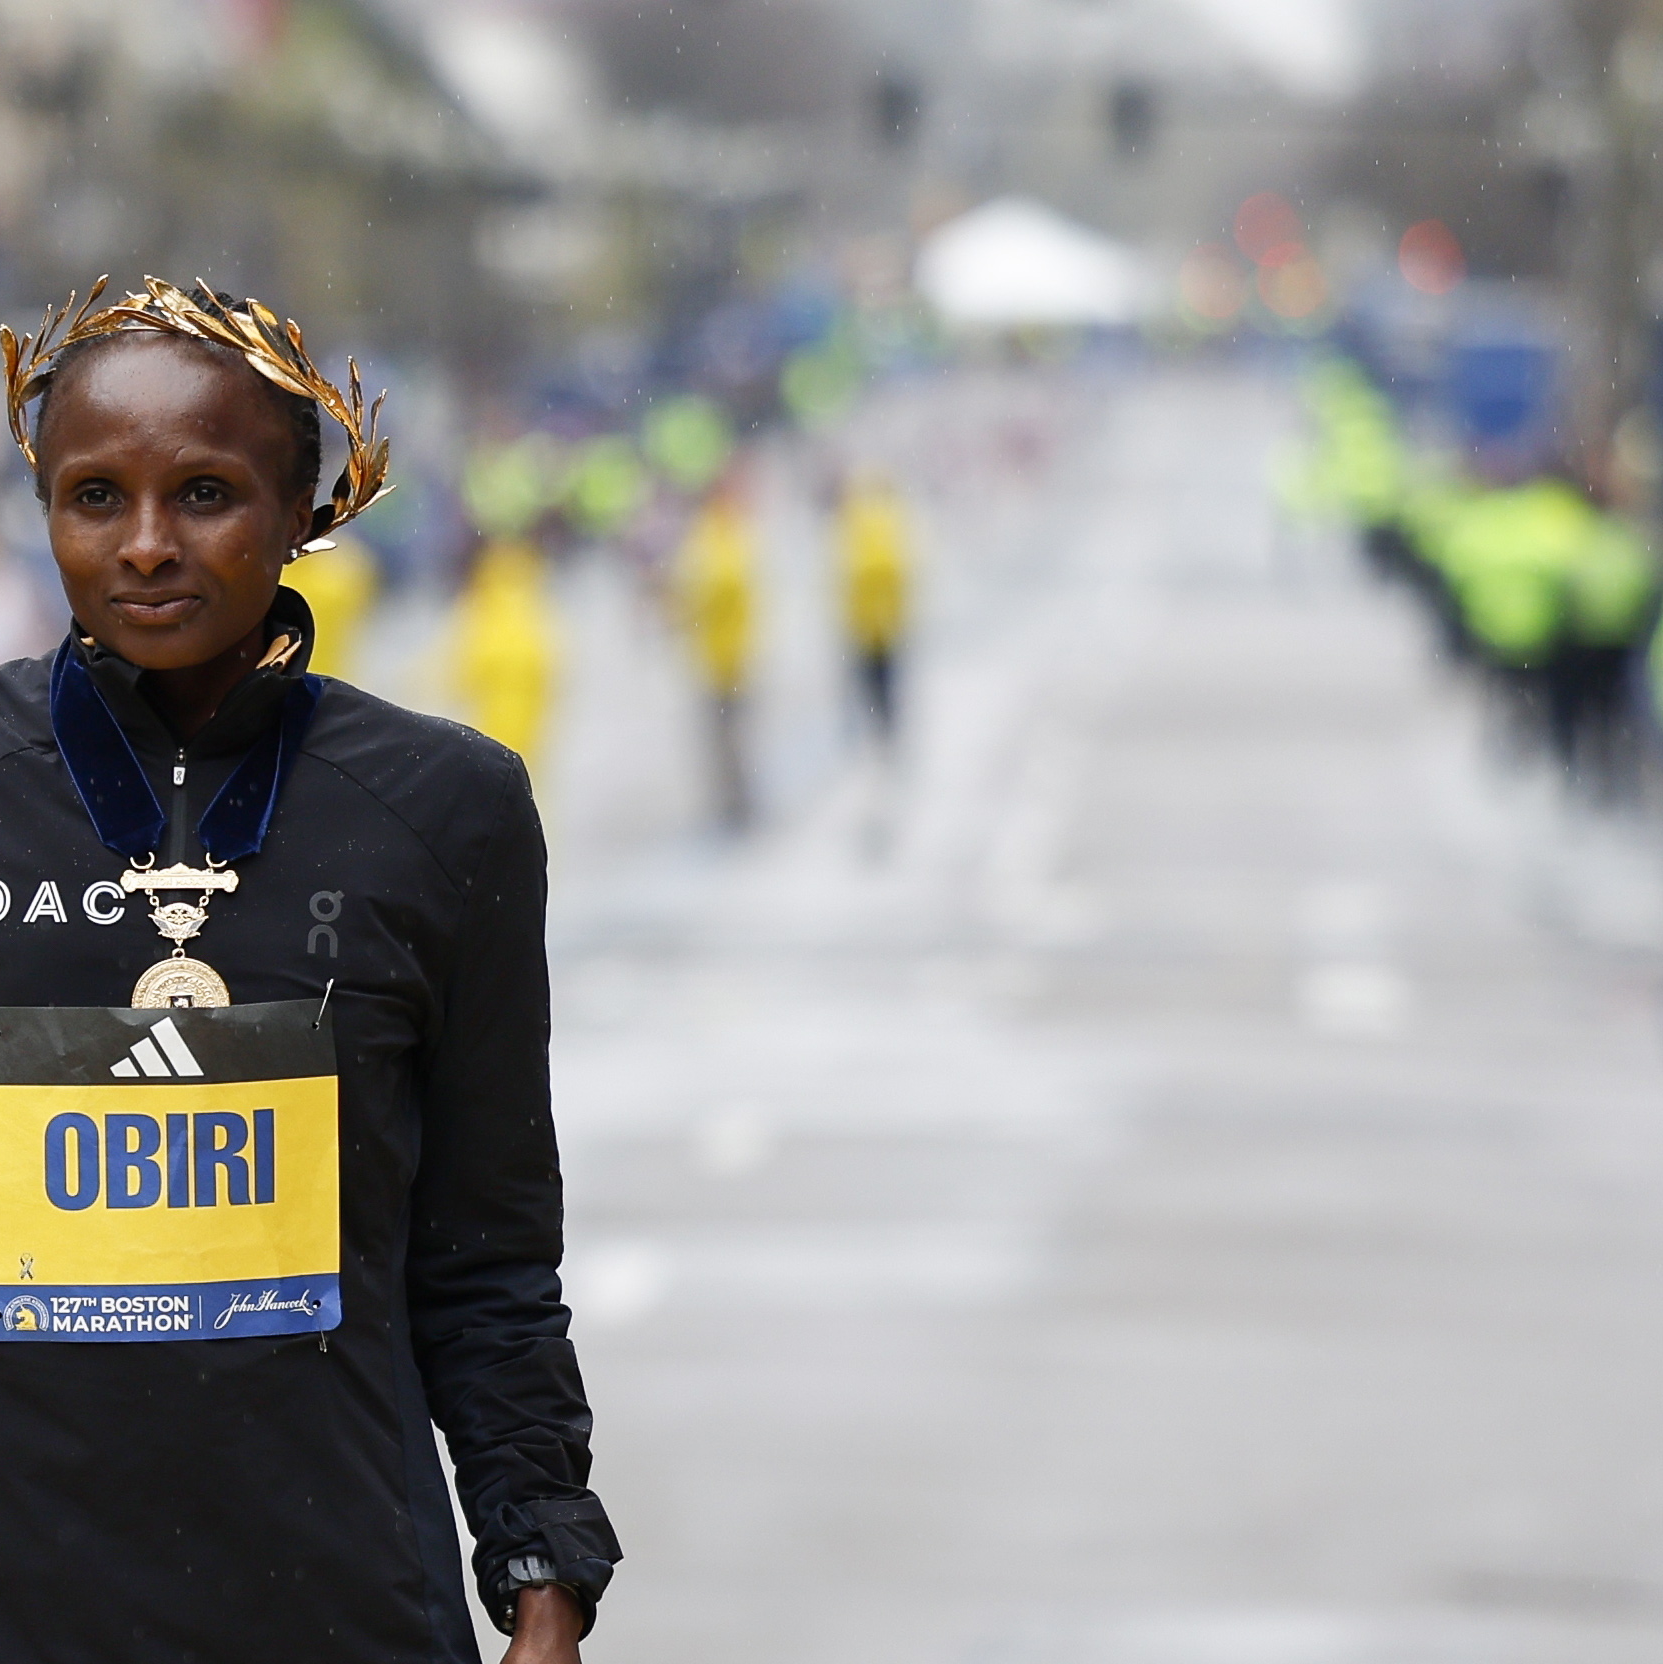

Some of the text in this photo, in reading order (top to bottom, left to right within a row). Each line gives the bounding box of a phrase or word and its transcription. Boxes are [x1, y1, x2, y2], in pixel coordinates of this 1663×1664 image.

[43, 1107, 276, 1212] OBIRI
[50, 1296, 98, 1314] 127TH
[101, 1295, 190, 1314] BOSTON
[213, 1292, 256, 1330] John
